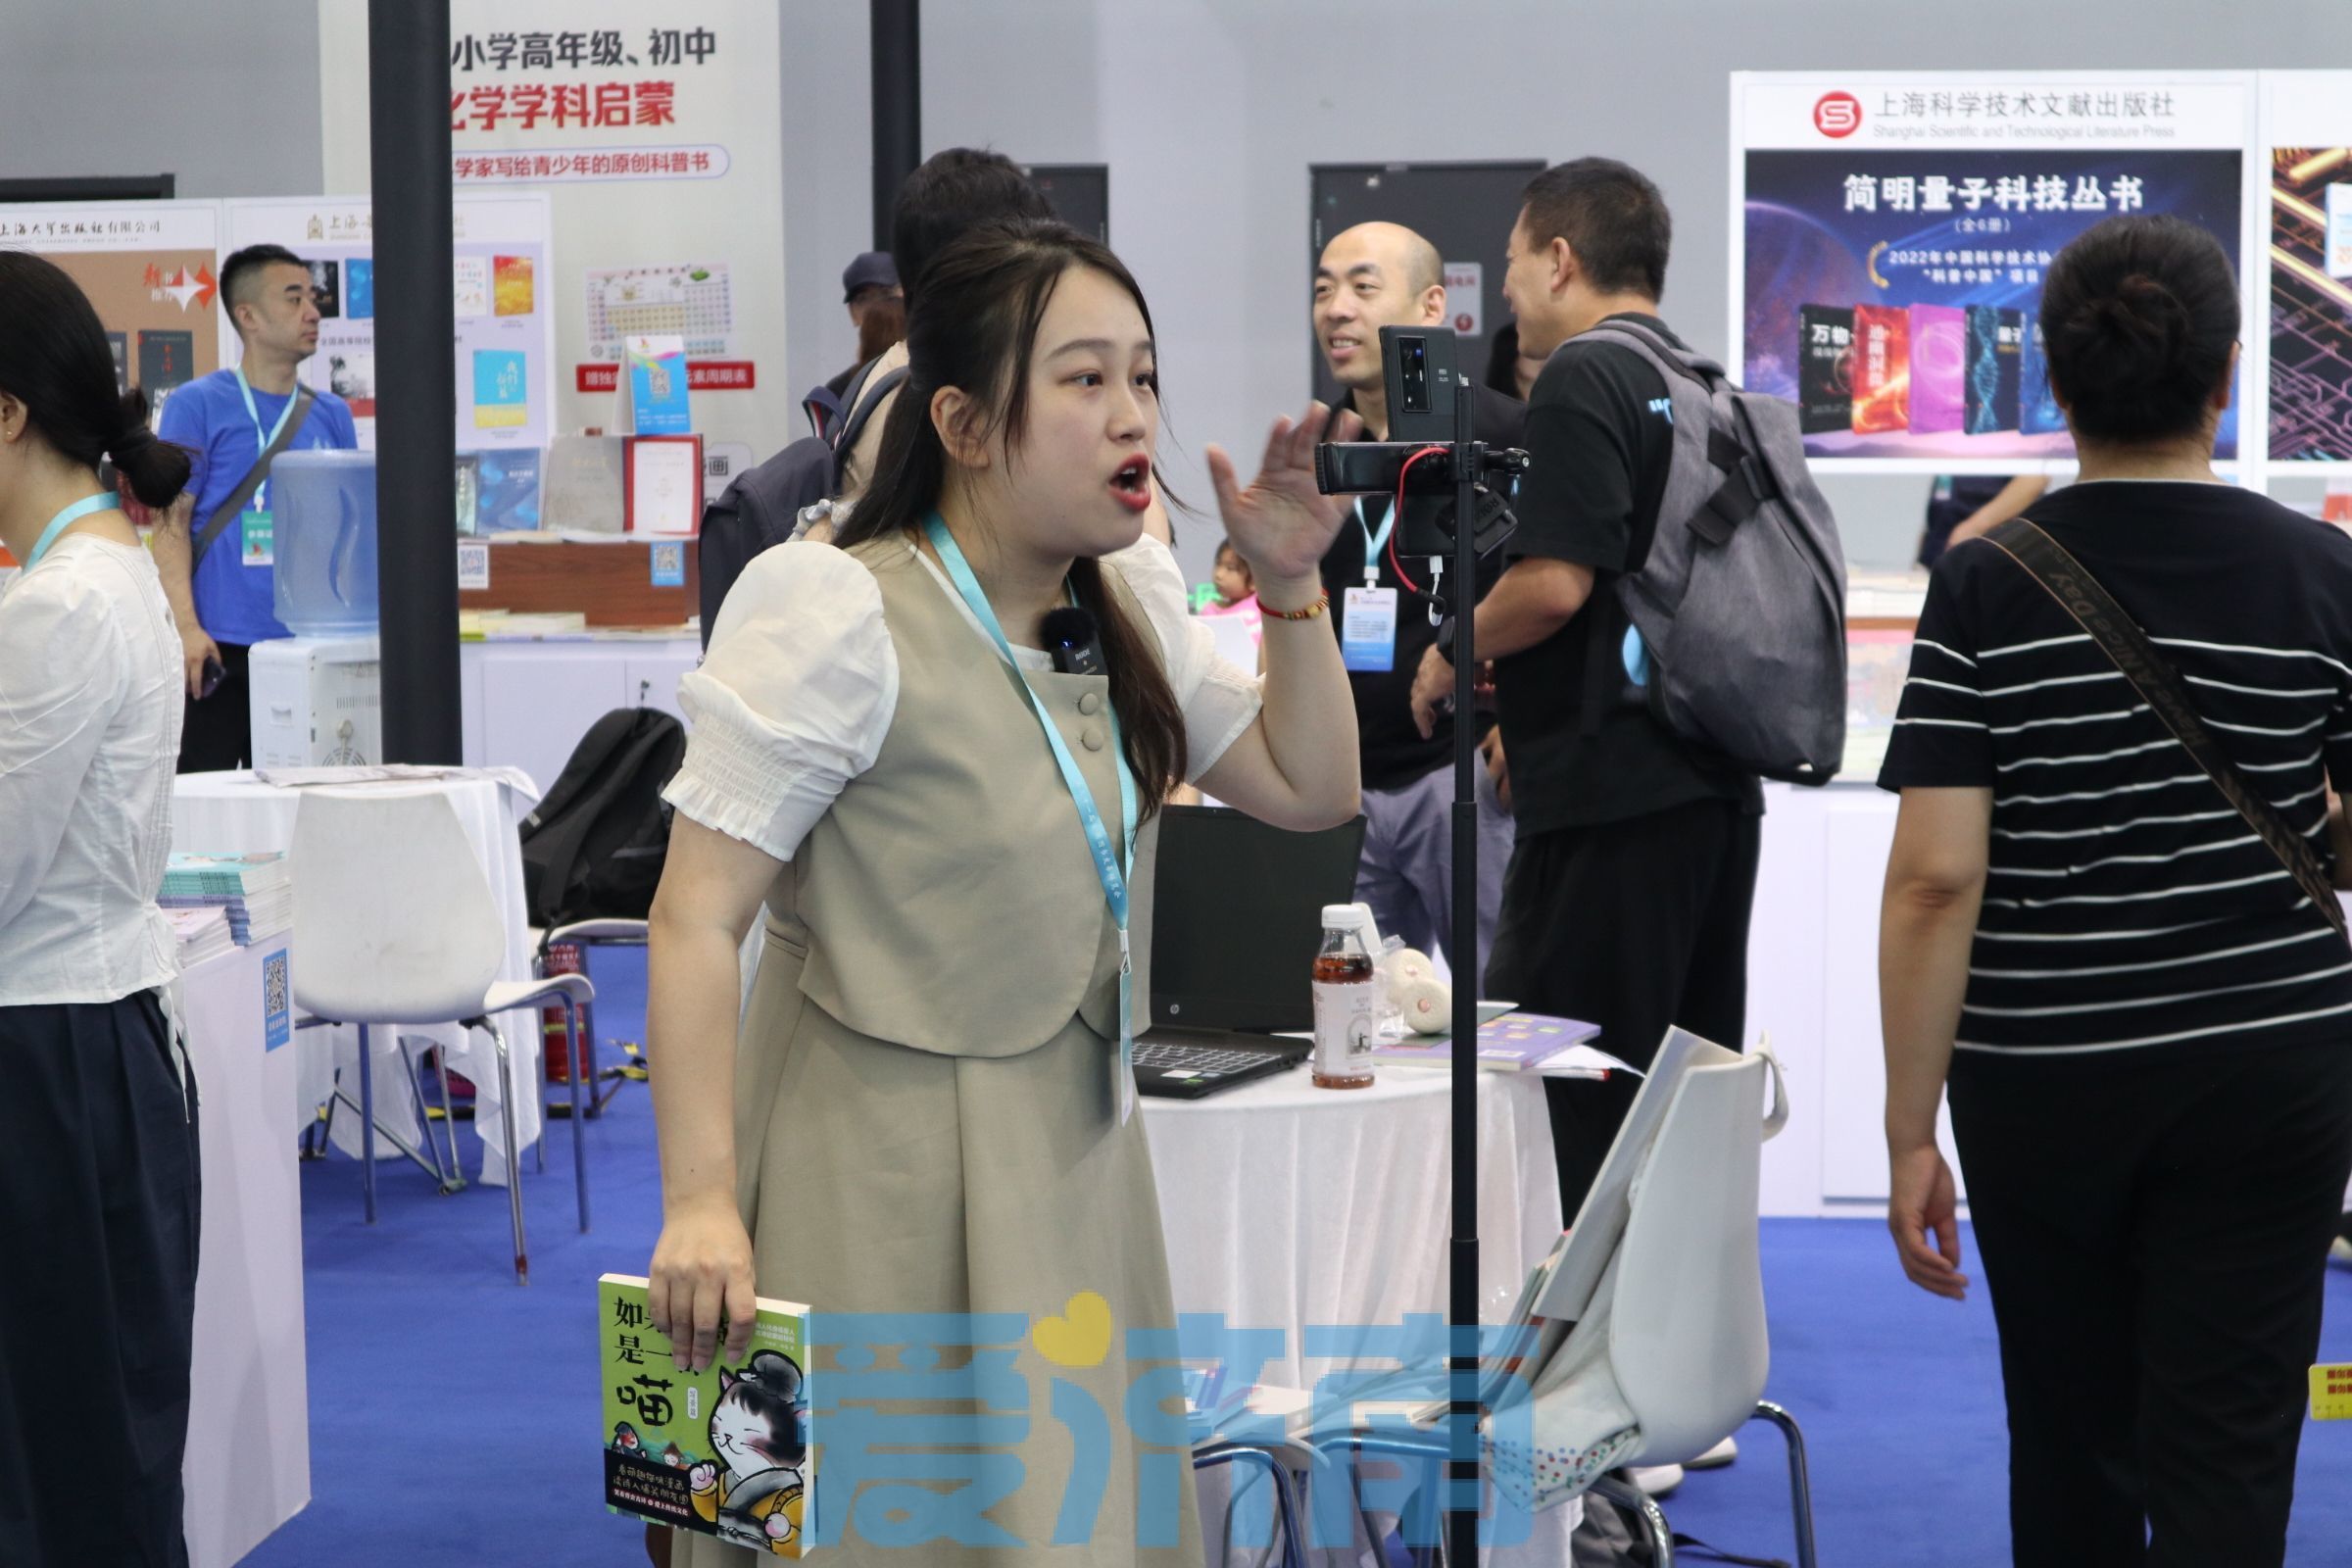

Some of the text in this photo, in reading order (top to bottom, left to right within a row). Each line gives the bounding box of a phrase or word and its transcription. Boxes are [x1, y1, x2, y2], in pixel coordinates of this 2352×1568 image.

[452, 27, 716, 72] 小学高年级、初中
[1874, 91, 2177, 118] 上海科学技术文献出版社
[1873, 124, 1925, 139] Shanghai
[1982, 124, 2003, 137] and
[2142, 124, 2176, 137] Press
[453, 152, 710, 178] 学家写给青少年的原创科普书
[1842, 173, 2144, 213] 简明量子科技丛书
[1811, 323, 1855, 345] 万物
[2045, 570, 2097, 616] Day
